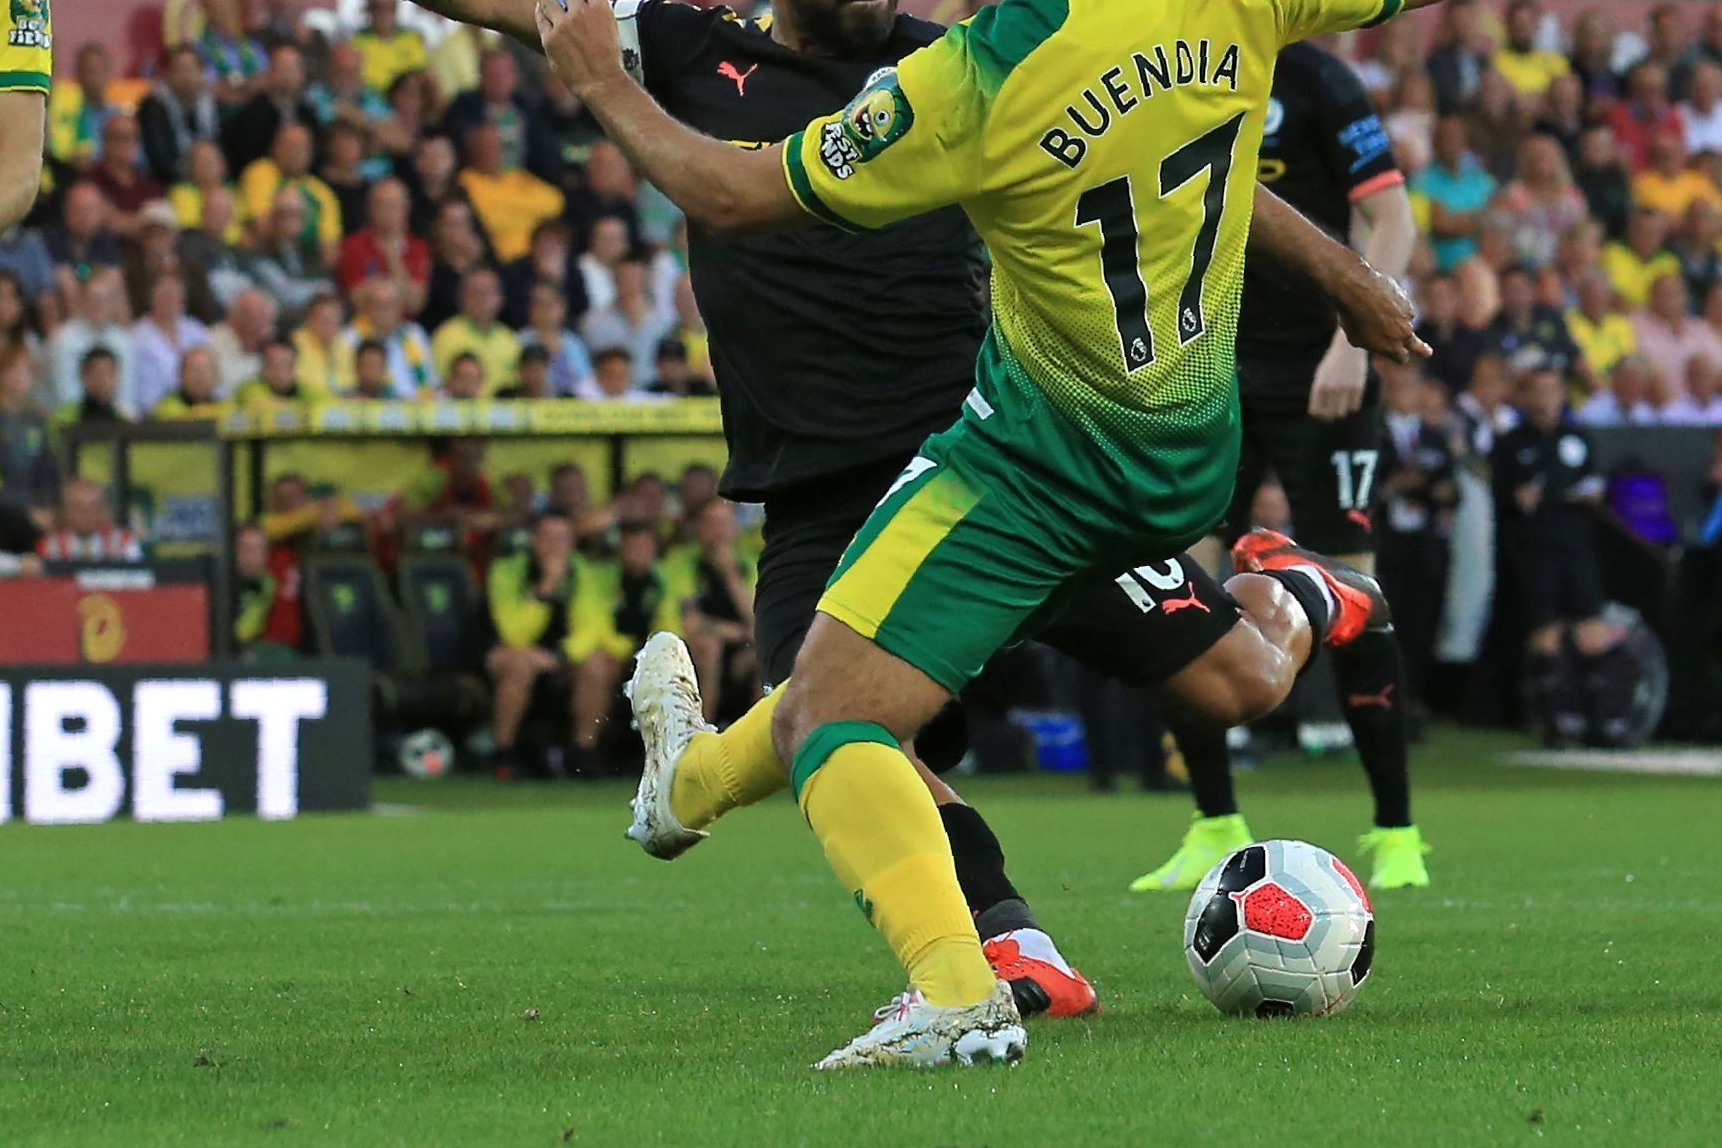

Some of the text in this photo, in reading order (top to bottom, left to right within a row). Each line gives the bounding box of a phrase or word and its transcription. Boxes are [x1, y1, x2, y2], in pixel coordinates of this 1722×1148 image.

[1037, 38, 1241, 170] BUENDIA
[1073, 109, 1247, 375] 17
[1330, 449, 1379, 510] 17
